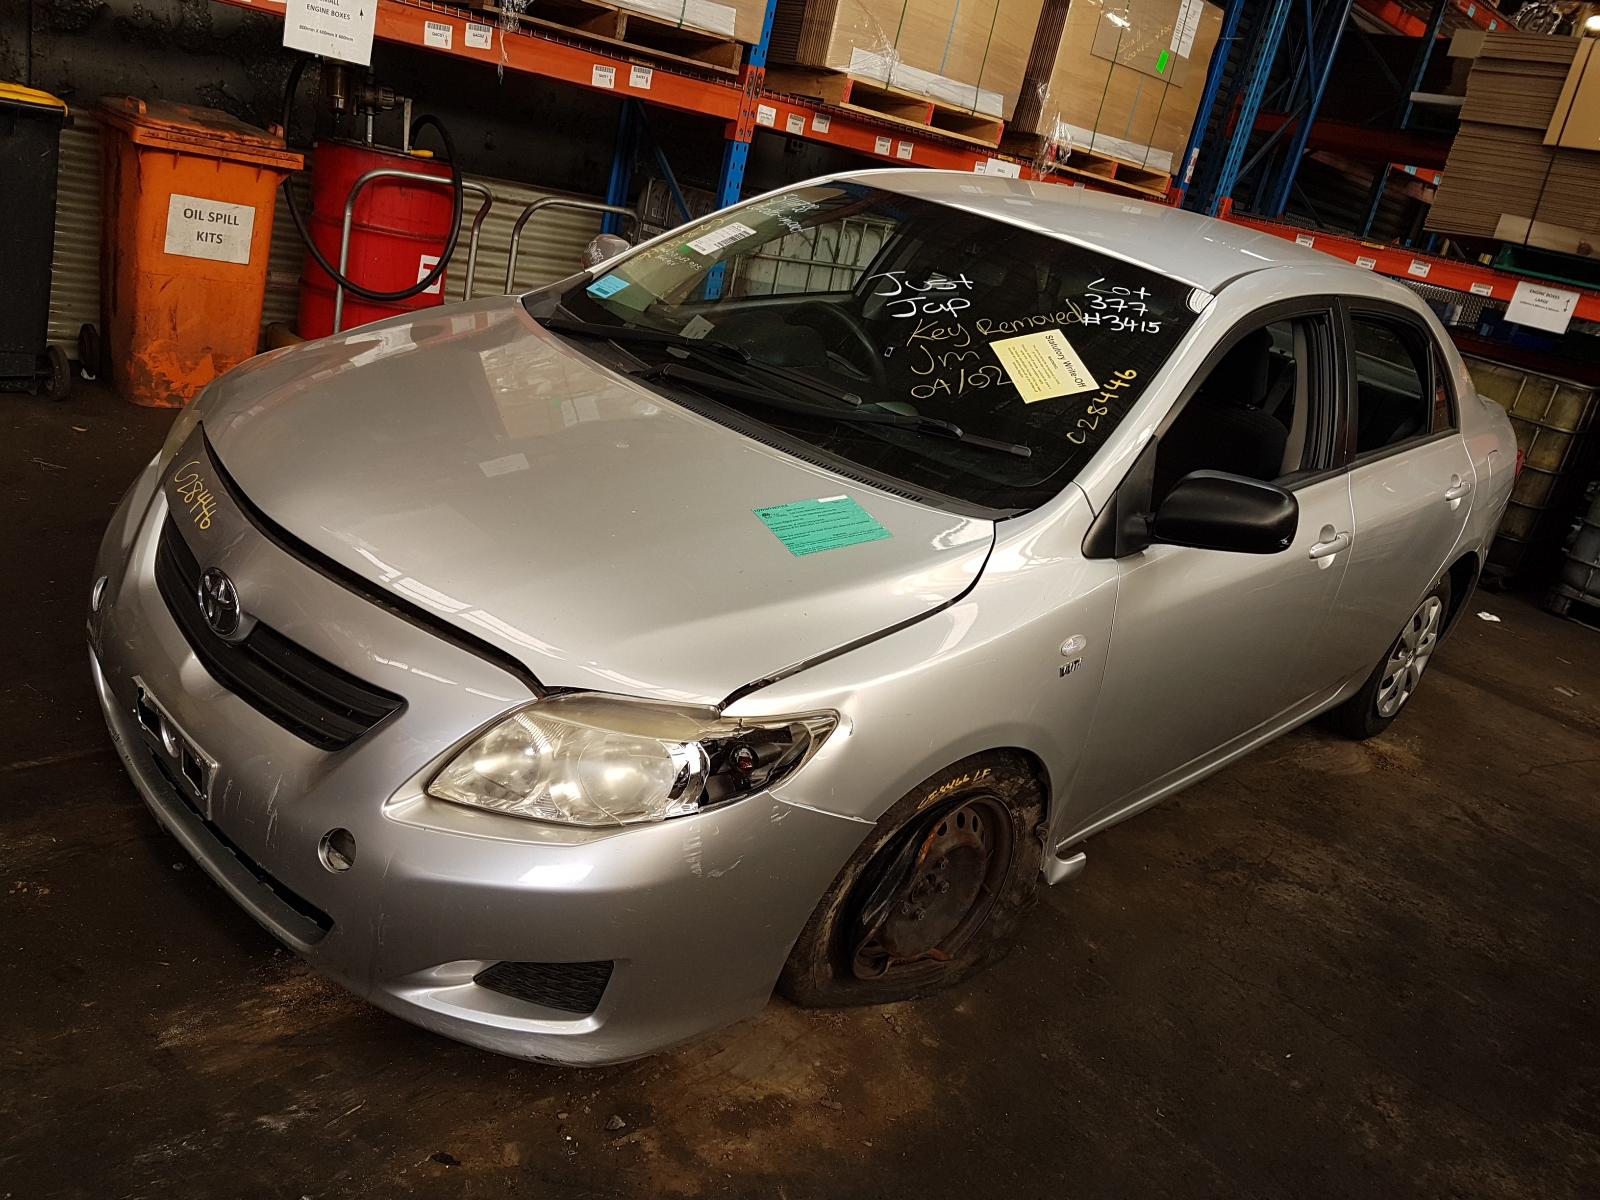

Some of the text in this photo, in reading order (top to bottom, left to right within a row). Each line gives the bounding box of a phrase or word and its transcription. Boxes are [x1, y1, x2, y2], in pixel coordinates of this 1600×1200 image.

[306, 3, 351, 20] ENGINE BOXES
[183, 208, 240, 226] OIL SPILL
[196, 230, 223, 244] KITS
[867, 270, 974, 297] Just
[1087, 277, 1152, 300] Lot
[886, 296, 971, 318] Jap
[1083, 293, 1149, 317] 377
[906, 298, 1085, 348] Key Removed
[1083, 312, 1163, 334] #3415
[1045, 334, 1088, 388] Statutory Write-Off
[1066, 369, 1137, 445] C28446
[174, 460, 217, 530] C28446
